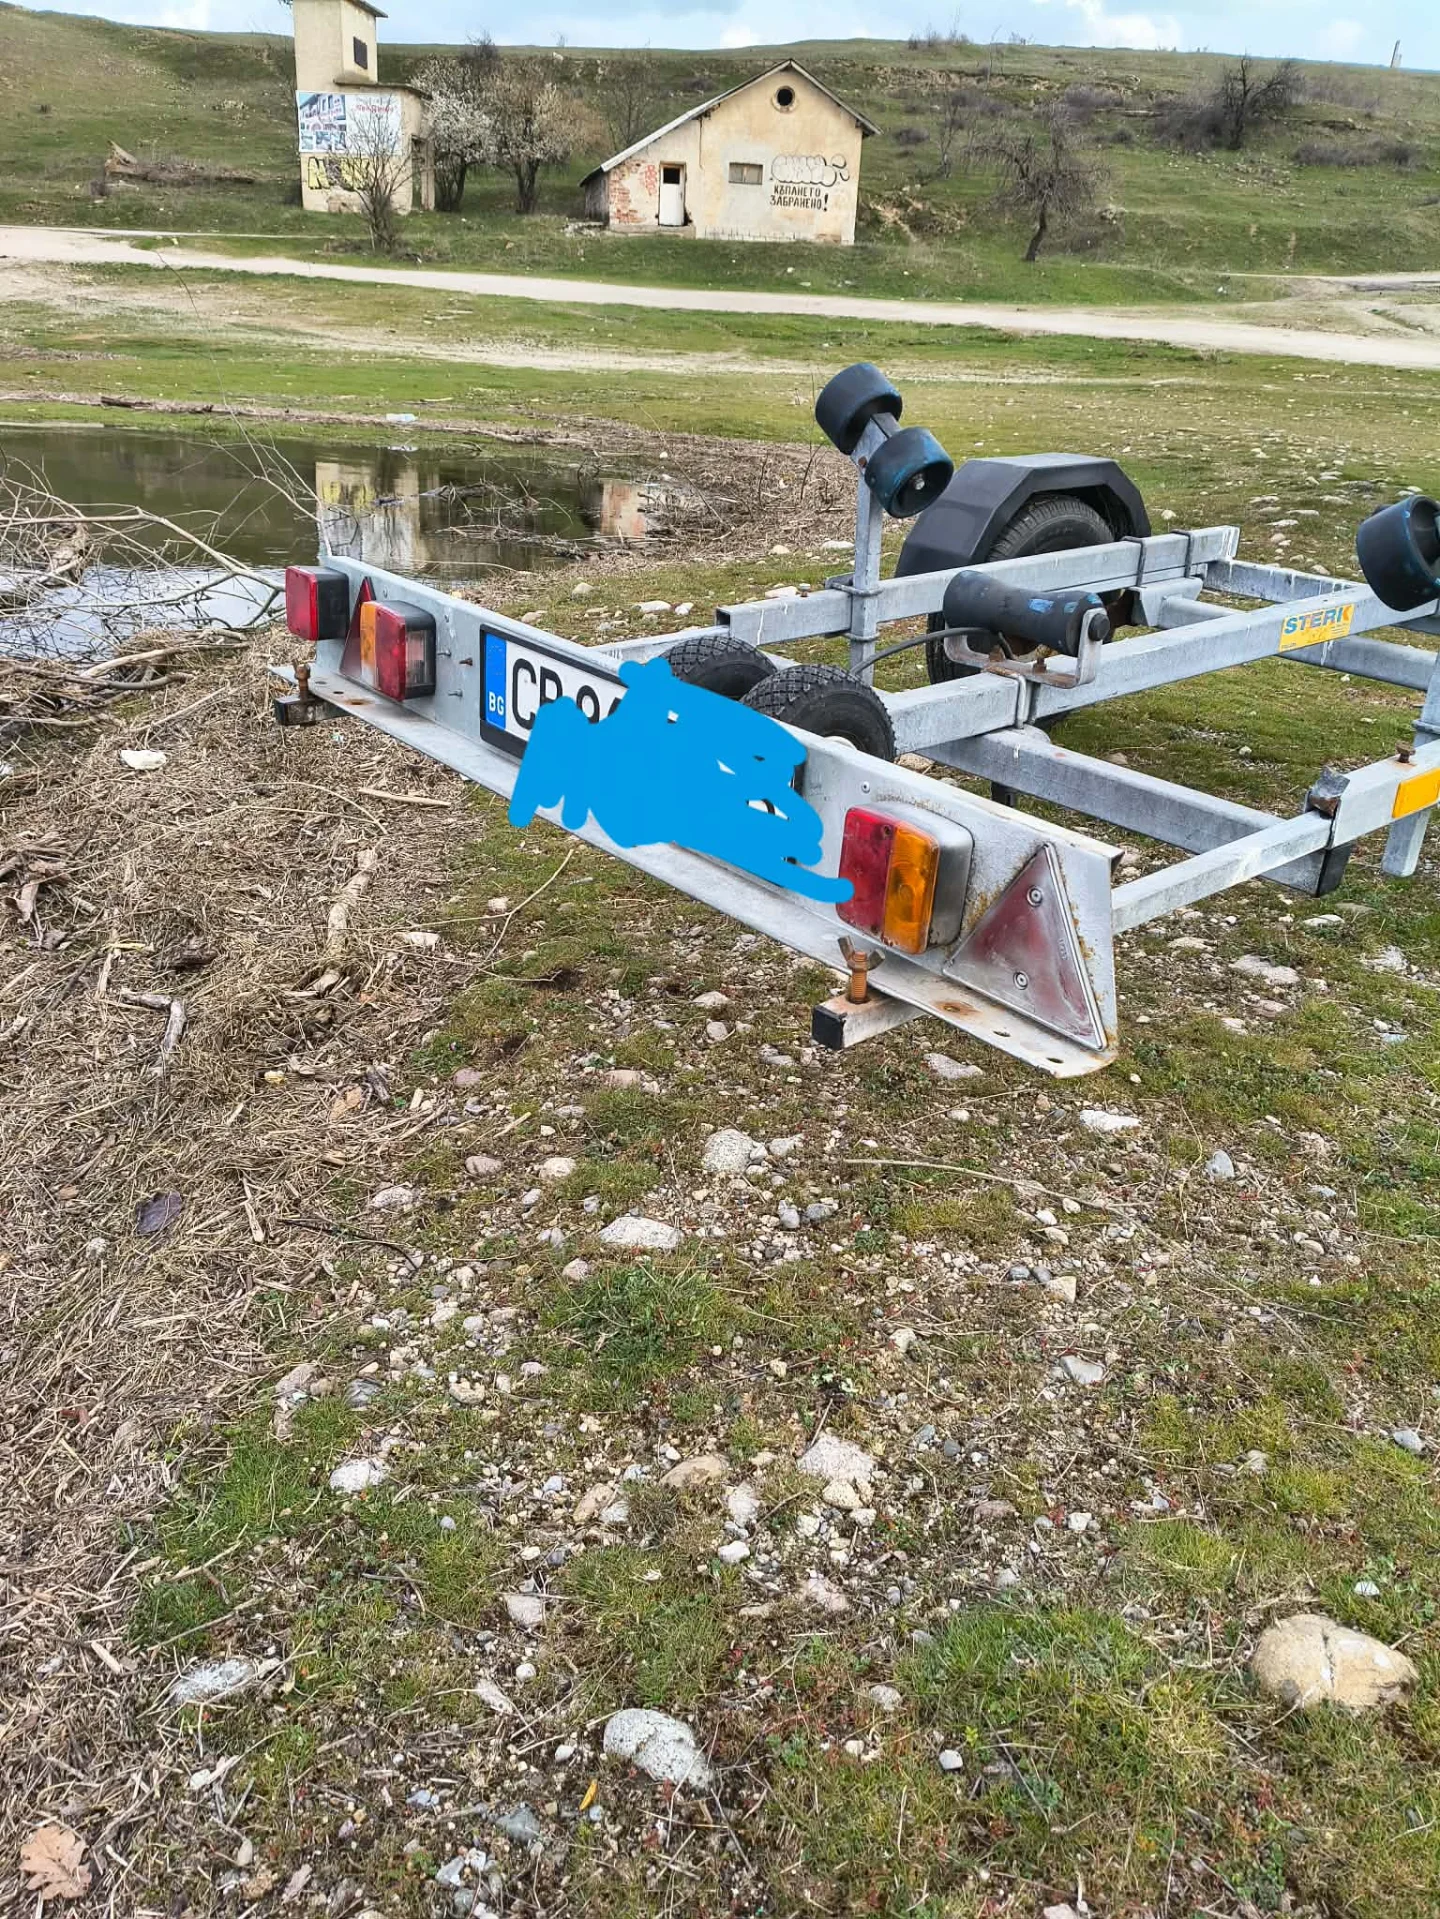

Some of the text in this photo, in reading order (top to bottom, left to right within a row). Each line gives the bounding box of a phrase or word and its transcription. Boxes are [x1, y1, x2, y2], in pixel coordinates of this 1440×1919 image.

[774, 185, 821, 197] КЪПАНЕТО
[1284, 605, 1352, 634] STERK
[488, 691, 505, 716] BG
